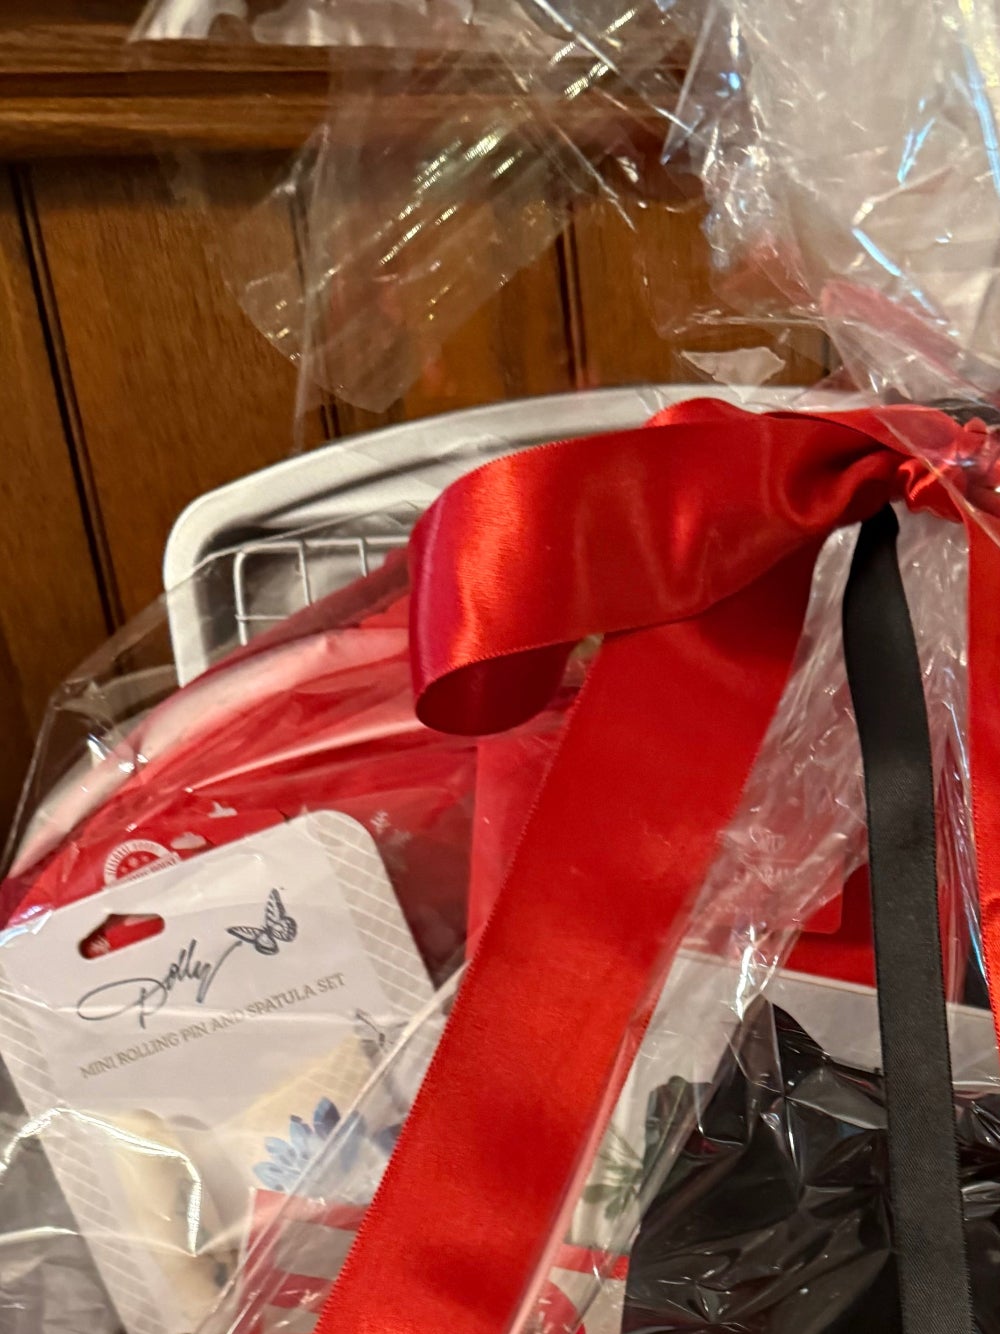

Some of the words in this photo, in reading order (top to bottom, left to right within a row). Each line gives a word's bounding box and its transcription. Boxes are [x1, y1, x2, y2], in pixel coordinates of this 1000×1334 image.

[77, 939, 242, 1029] Dolly
[80, 1056, 117, 1079] MINI
[117, 1032, 180, 1068] ROLLING
[181, 1020, 210, 1043] PIN
[211, 1008, 249, 1032] AND
[247, 983, 318, 1018] SPATULA
[317, 972, 346, 995] SET
